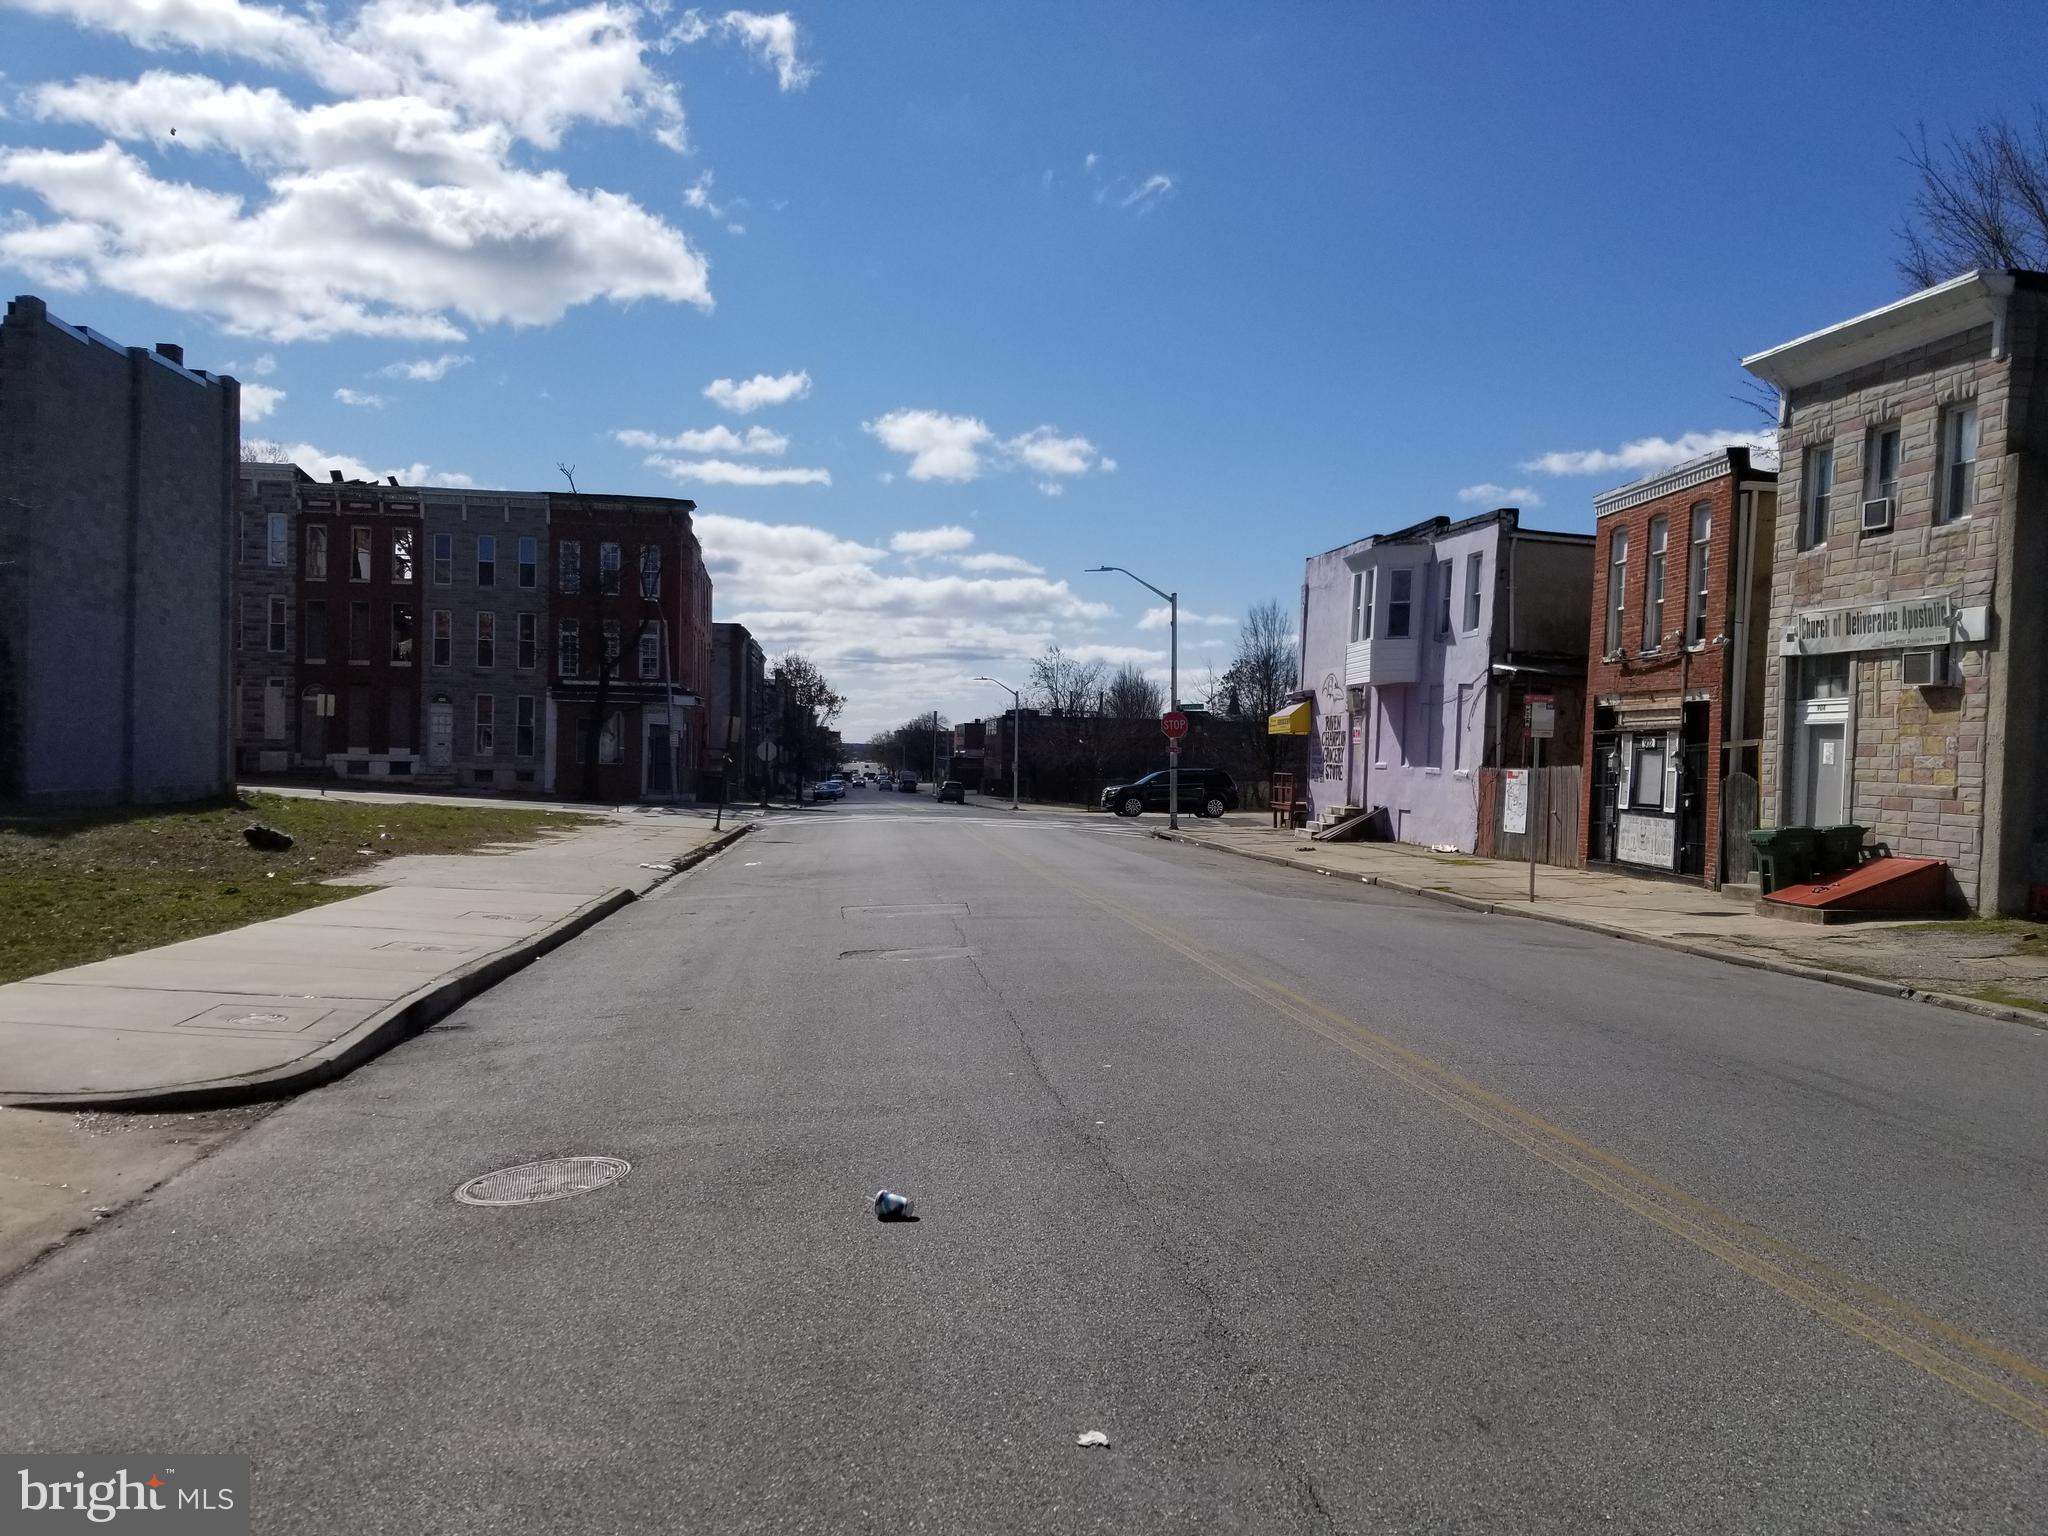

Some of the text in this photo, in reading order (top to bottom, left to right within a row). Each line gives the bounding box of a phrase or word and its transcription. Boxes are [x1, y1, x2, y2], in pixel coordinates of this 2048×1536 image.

[1801, 602, 1947, 639] Church of Deliverance Apostolic
[1163, 720, 1185, 730] STOP
[1325, 716, 1341, 731] RAVEN
[1324, 747, 1344, 763] GROCERY
[1325, 765, 1343, 781] STORE
